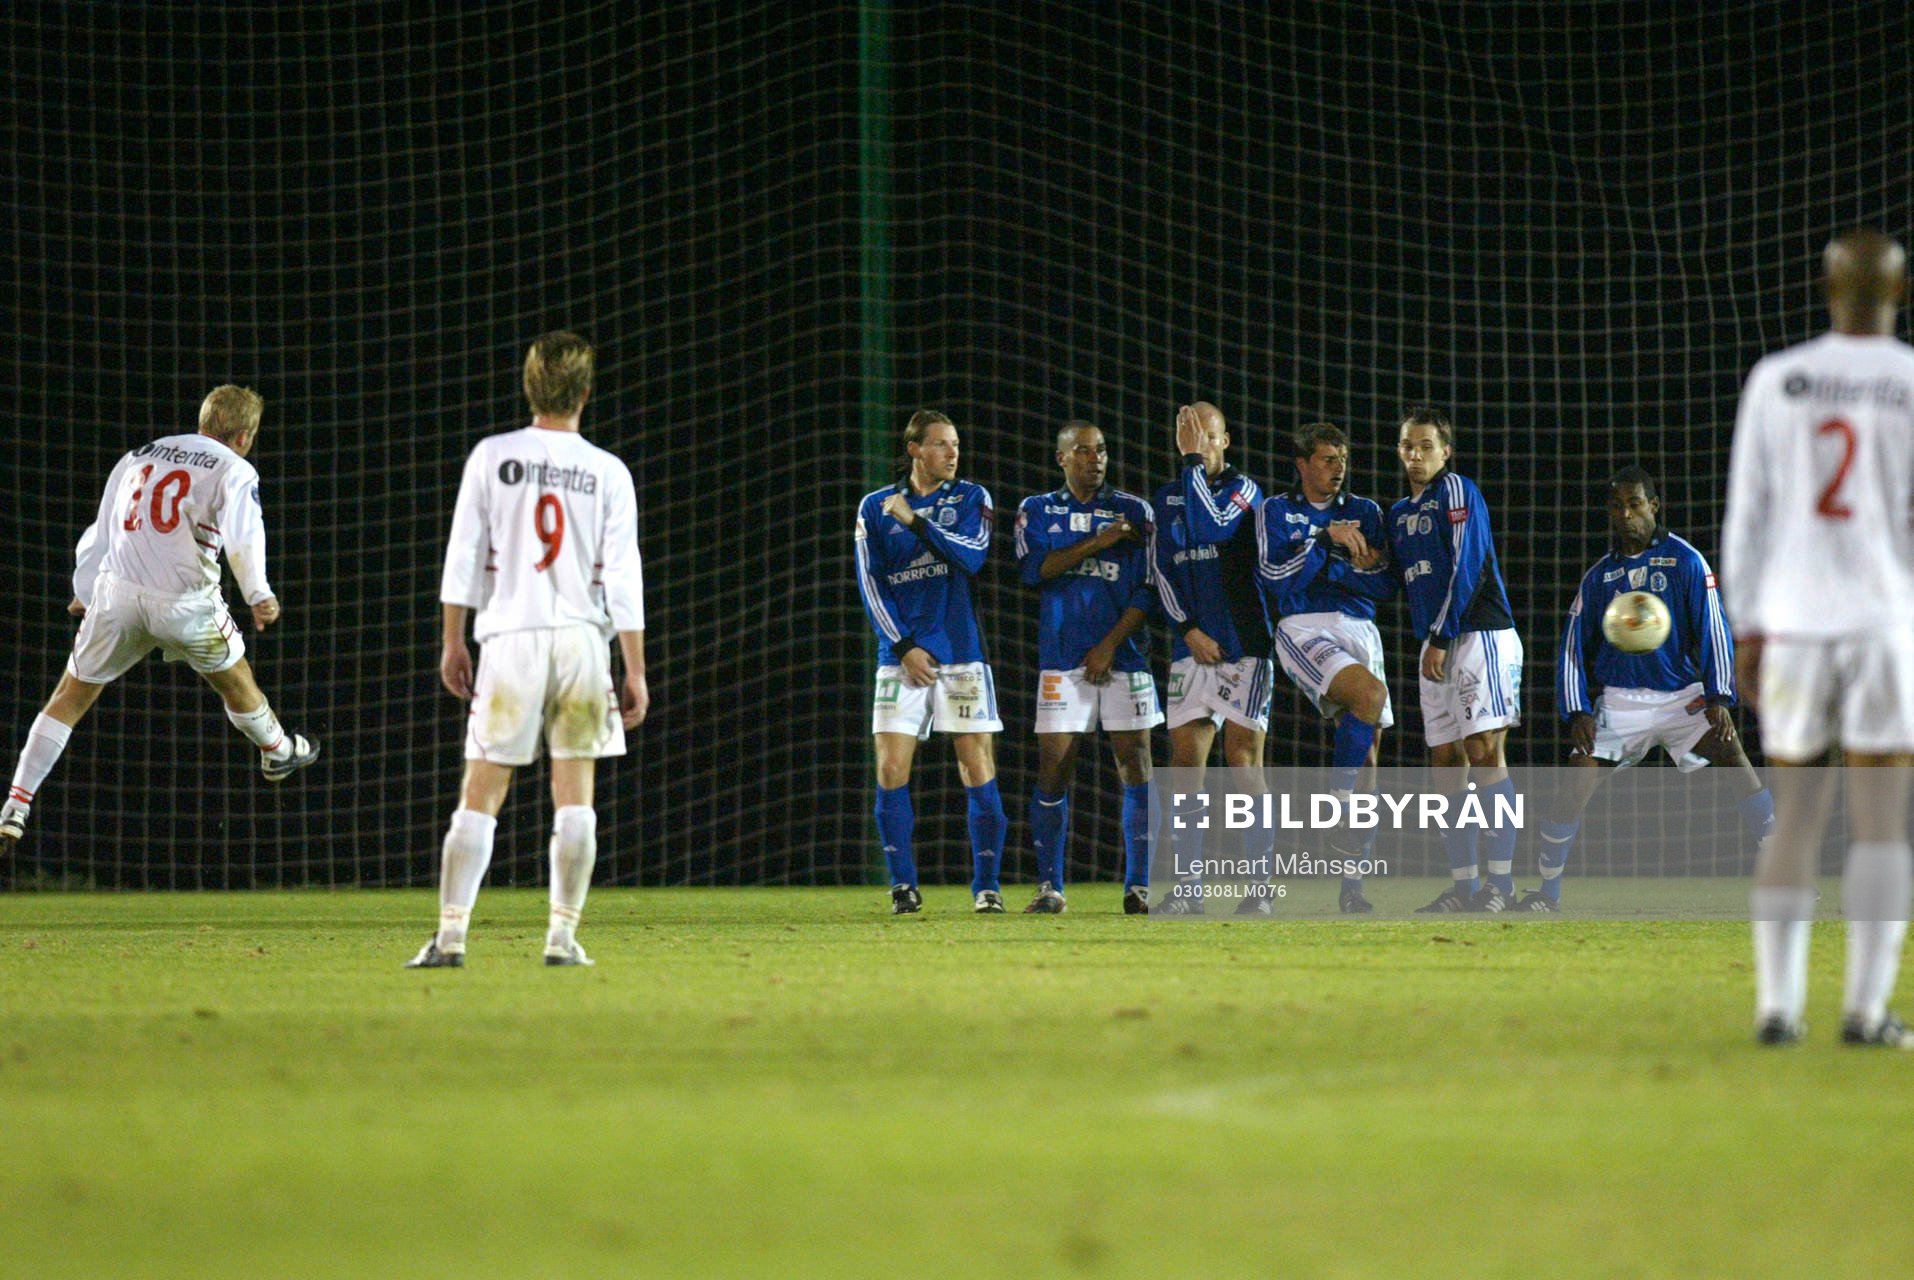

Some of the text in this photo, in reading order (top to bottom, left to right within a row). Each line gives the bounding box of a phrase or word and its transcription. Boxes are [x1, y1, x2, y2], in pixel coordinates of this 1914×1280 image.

[149, 443, 220, 470] intentia
[1816, 416, 1858, 519] 2
[526, 459, 598, 496] intentia
[124, 464, 191, 534] 10
[534, 491, 565, 573] 9
[958, 704, 971, 718] 11
[1465, 706, 1473, 721] 3
